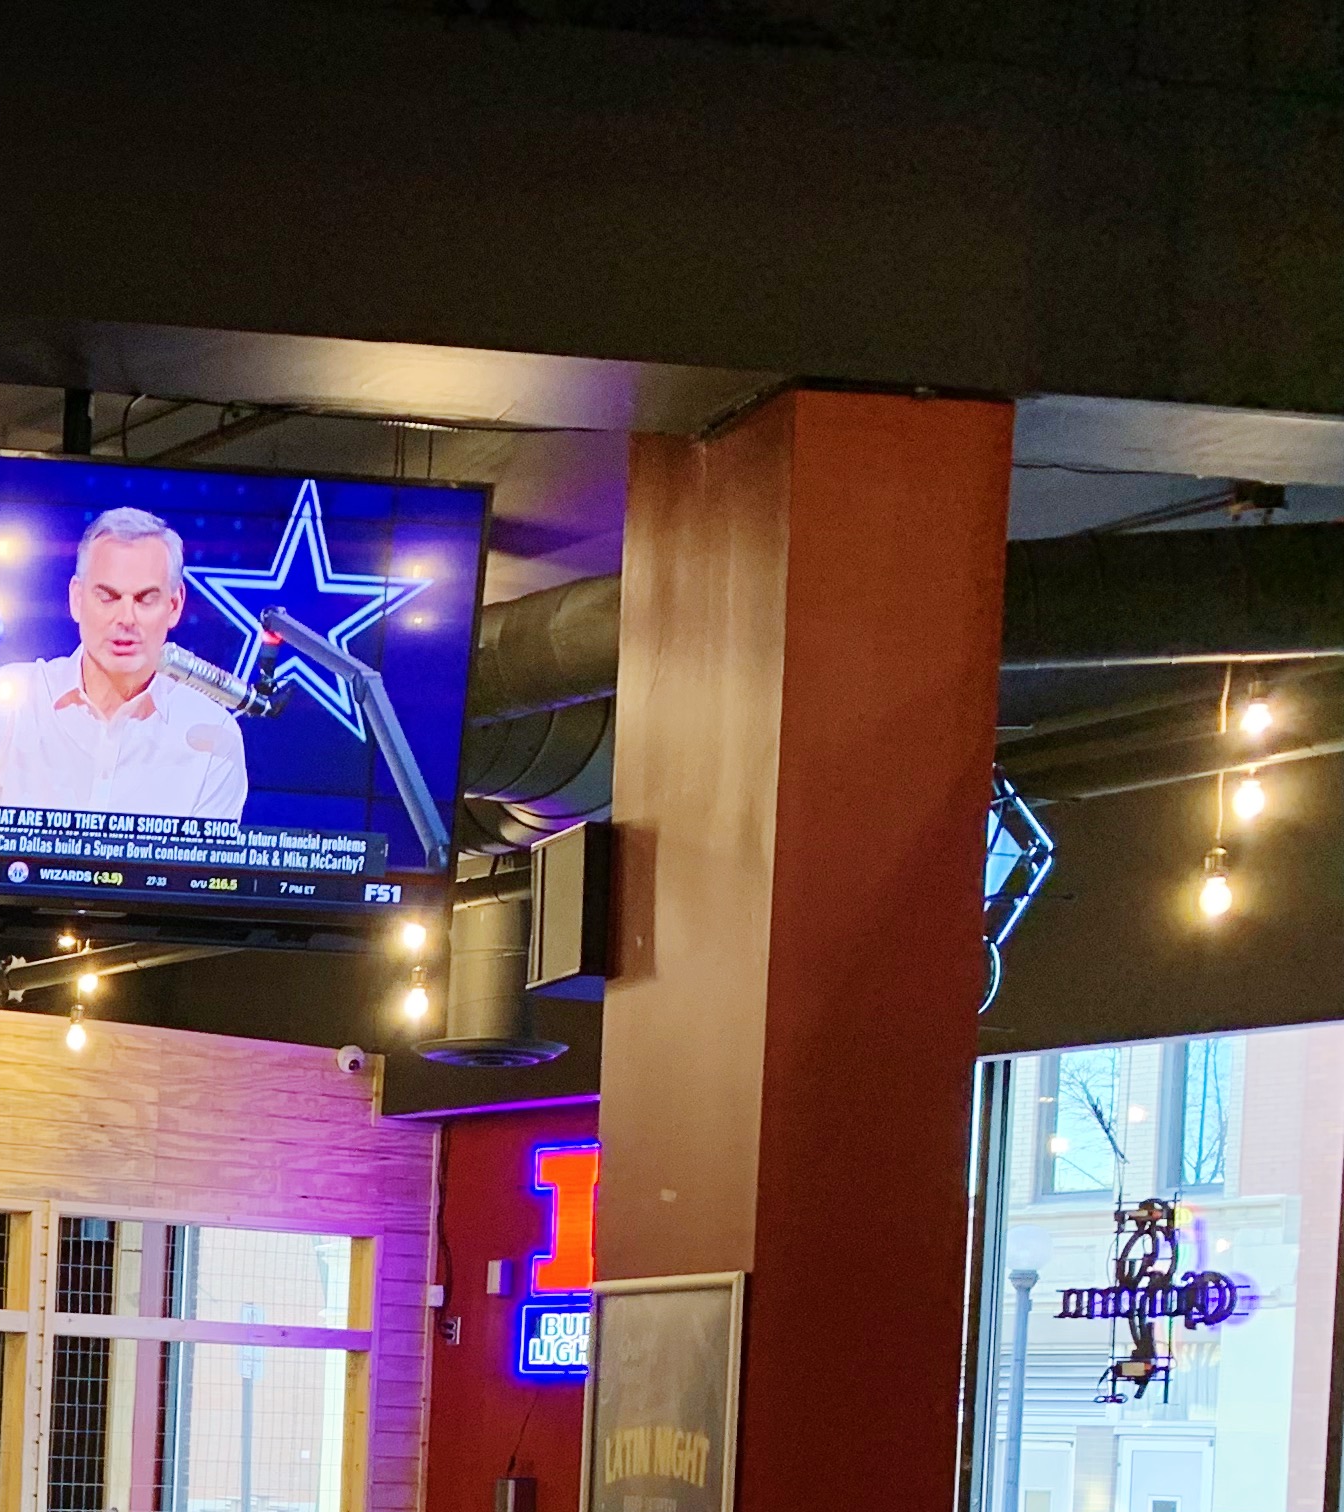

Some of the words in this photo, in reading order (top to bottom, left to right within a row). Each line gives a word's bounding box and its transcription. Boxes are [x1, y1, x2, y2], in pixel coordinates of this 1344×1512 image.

[17, 809, 44, 827] ARE
[46, 811, 73, 829] YOU
[74, 813, 108, 831] THEY
[108, 816, 135, 832] CAN
[137, 817, 180, 835] SHOOT
[180, 819, 201, 837] 40,
[203, 820, 239, 838] SHOO
[18, 835, 53, 853] Dallas
[54, 837, 83, 855] build
[83, 843, 91, 856] a
[92, 840, 125, 861] Super
[126, 842, 154, 859] Bowl
[154, 844, 207, 863] contender
[209, 847, 246, 864] around
[248, 849, 270, 866] Dak
[271, 850, 281, 867] &
[282, 851, 308, 868] Mike
[309, 852, 366, 875] McCarthy?
[248, 830, 278, 848] future
[279, 832, 321, 850] financial
[321, 835, 367, 855] problems
[39, 868, 92, 883] WIZARDS
[279, 882, 287, 894] 7
[288, 884, 303, 895] PM
[303, 885, 316, 895] ET
[364, 884, 402, 903] FS1
[528, 1337, 590, 1366] LIGH
[605, 1426, 650, 1484] LATIN
[653, 1426, 710, 1488] NIGHT
